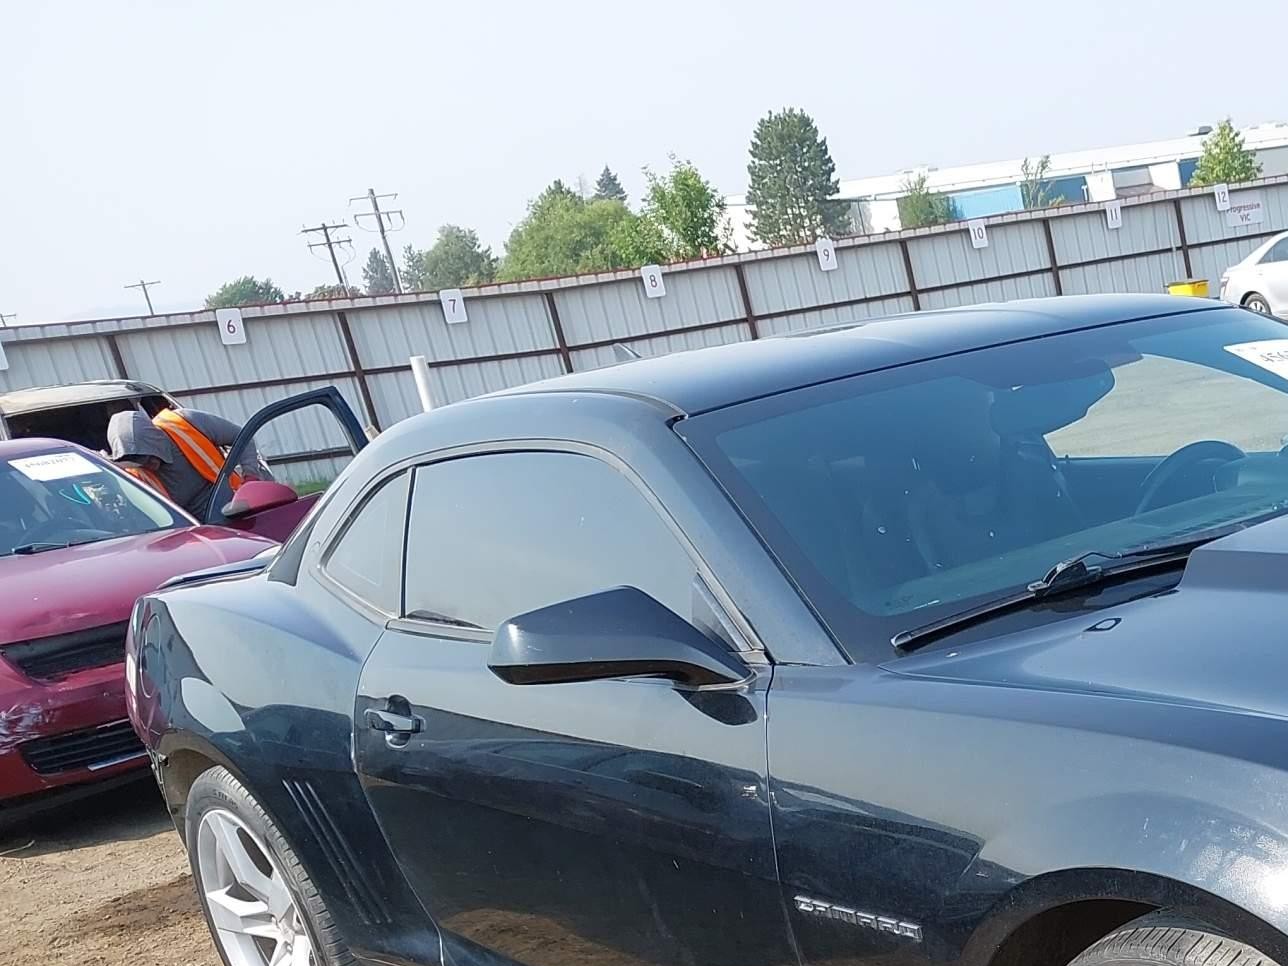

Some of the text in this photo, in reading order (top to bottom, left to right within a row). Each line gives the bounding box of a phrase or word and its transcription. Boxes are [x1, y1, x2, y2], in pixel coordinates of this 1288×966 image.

[1218, 191, 1227, 203] 12
[1110, 207, 1119, 221] 11
[972, 227, 985, 241] 10
[823, 249, 830, 261] 9
[649, 275, 658, 288] 8
[449, 299, 457, 313] 7
[227, 320, 236, 334] 6
